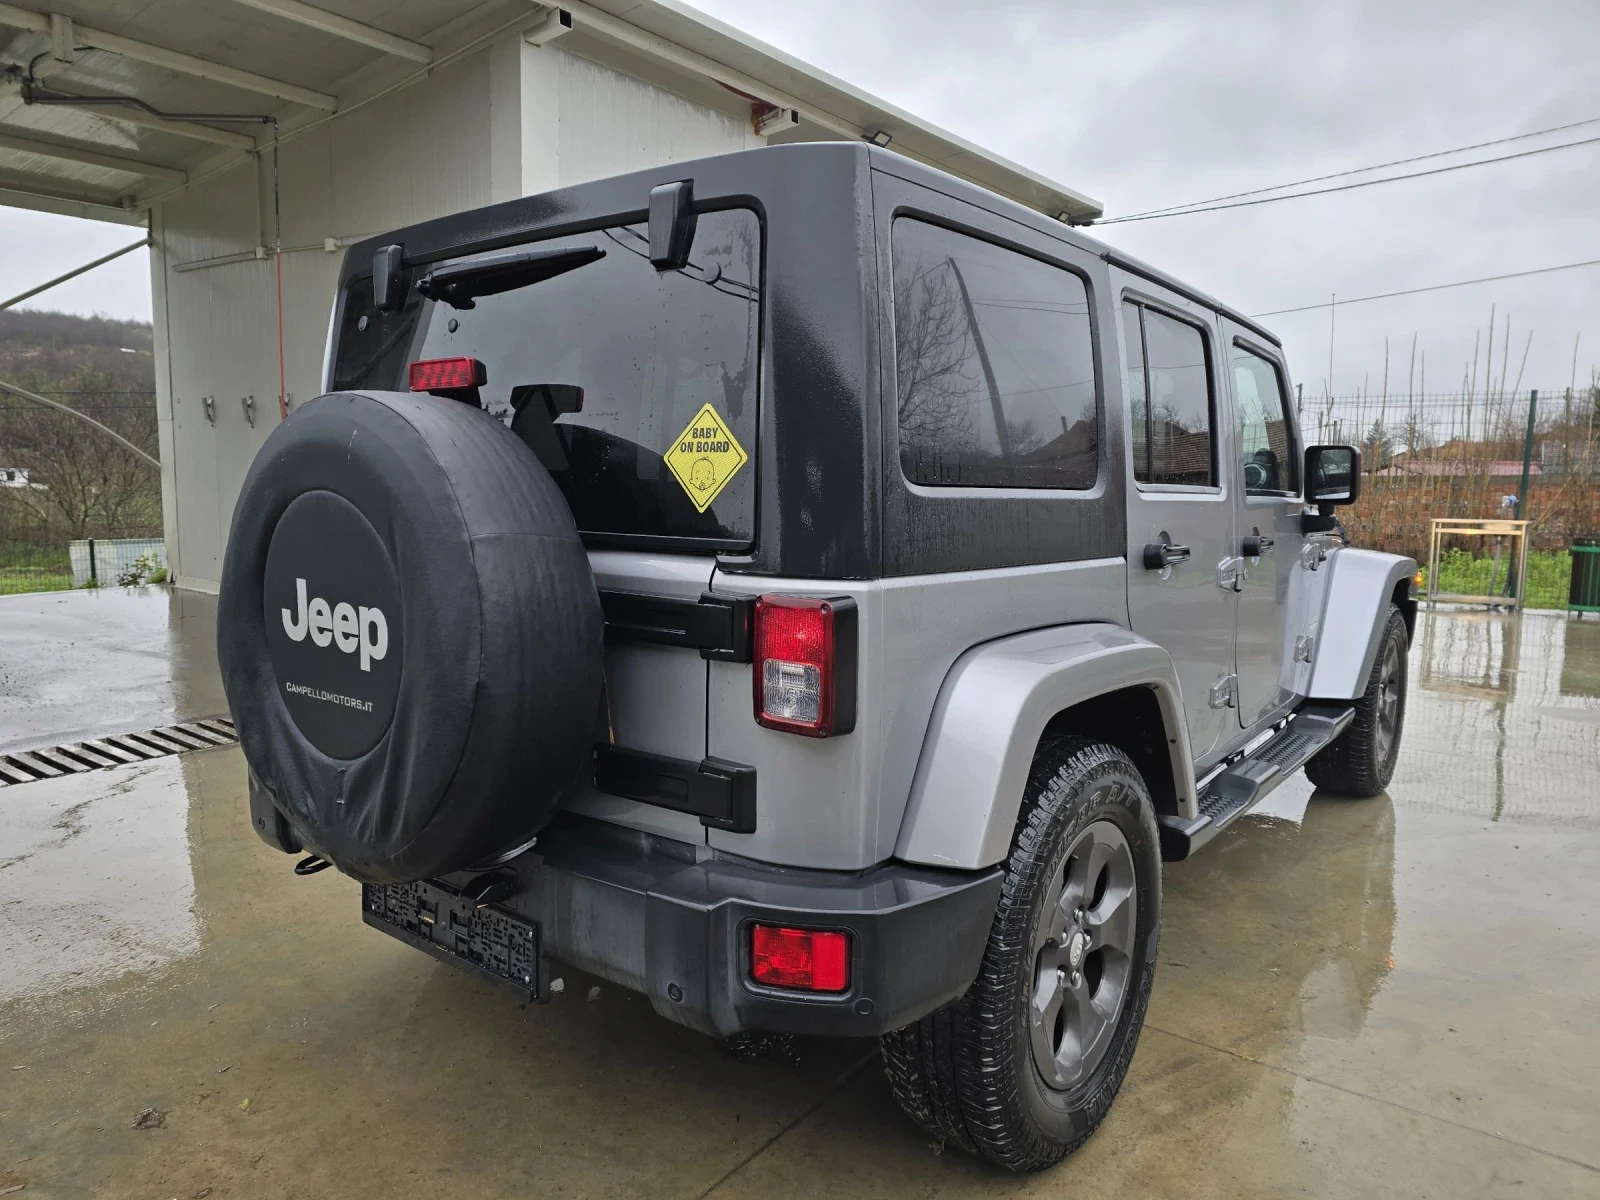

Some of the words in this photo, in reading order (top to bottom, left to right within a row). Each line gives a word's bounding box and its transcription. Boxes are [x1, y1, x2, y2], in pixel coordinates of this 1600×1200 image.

[692, 427, 719, 439] BABY
[680, 441, 694, 453] ON
[696, 441, 730, 453] BOARD
[281, 577, 389, 672] Jeep
[286, 682, 374, 712] CAMPELLOMOTORS.IT
[1105, 783, 1140, 807] A/T
[1084, 964, 1154, 1126] YOKOHAMA
